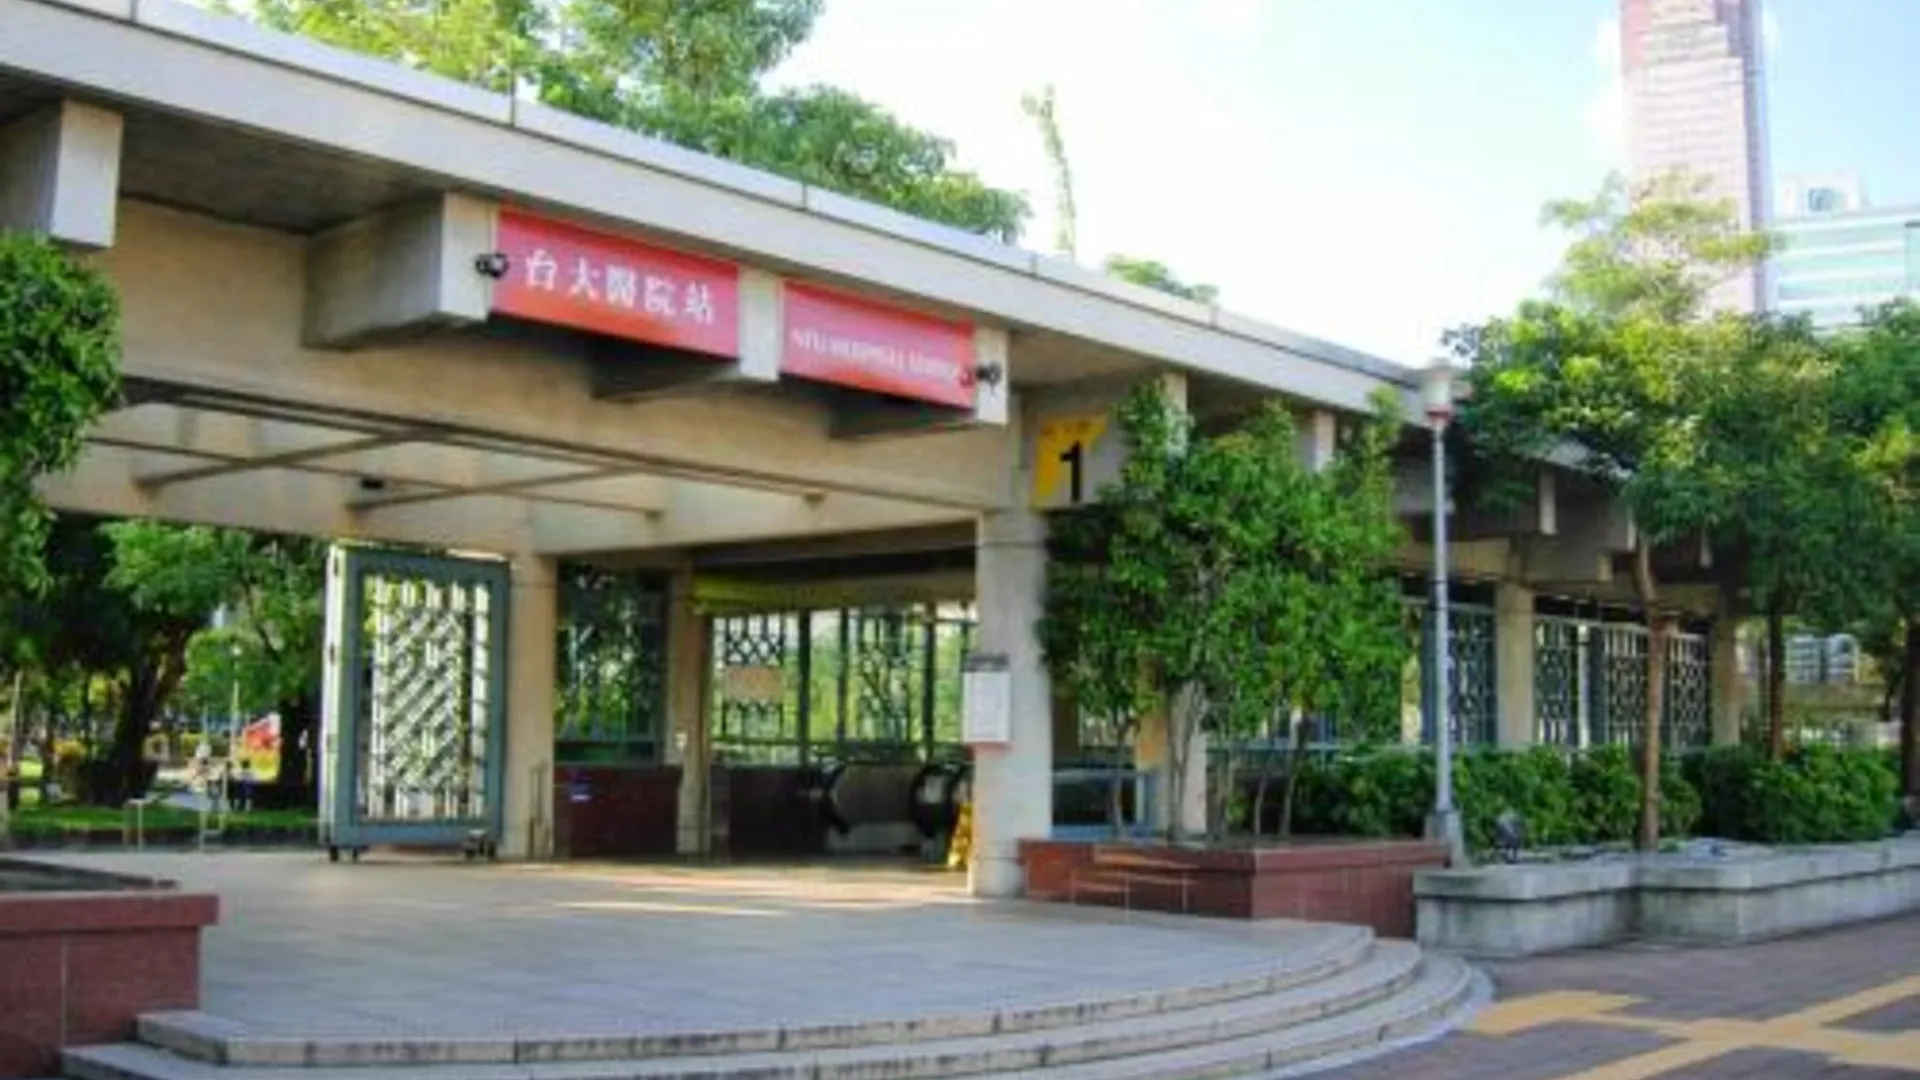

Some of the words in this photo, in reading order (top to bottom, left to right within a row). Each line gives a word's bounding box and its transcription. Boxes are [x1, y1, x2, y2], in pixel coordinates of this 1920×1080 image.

[525, 249, 715, 325] 台大醫院站
[1059, 440, 1082, 502] 1
